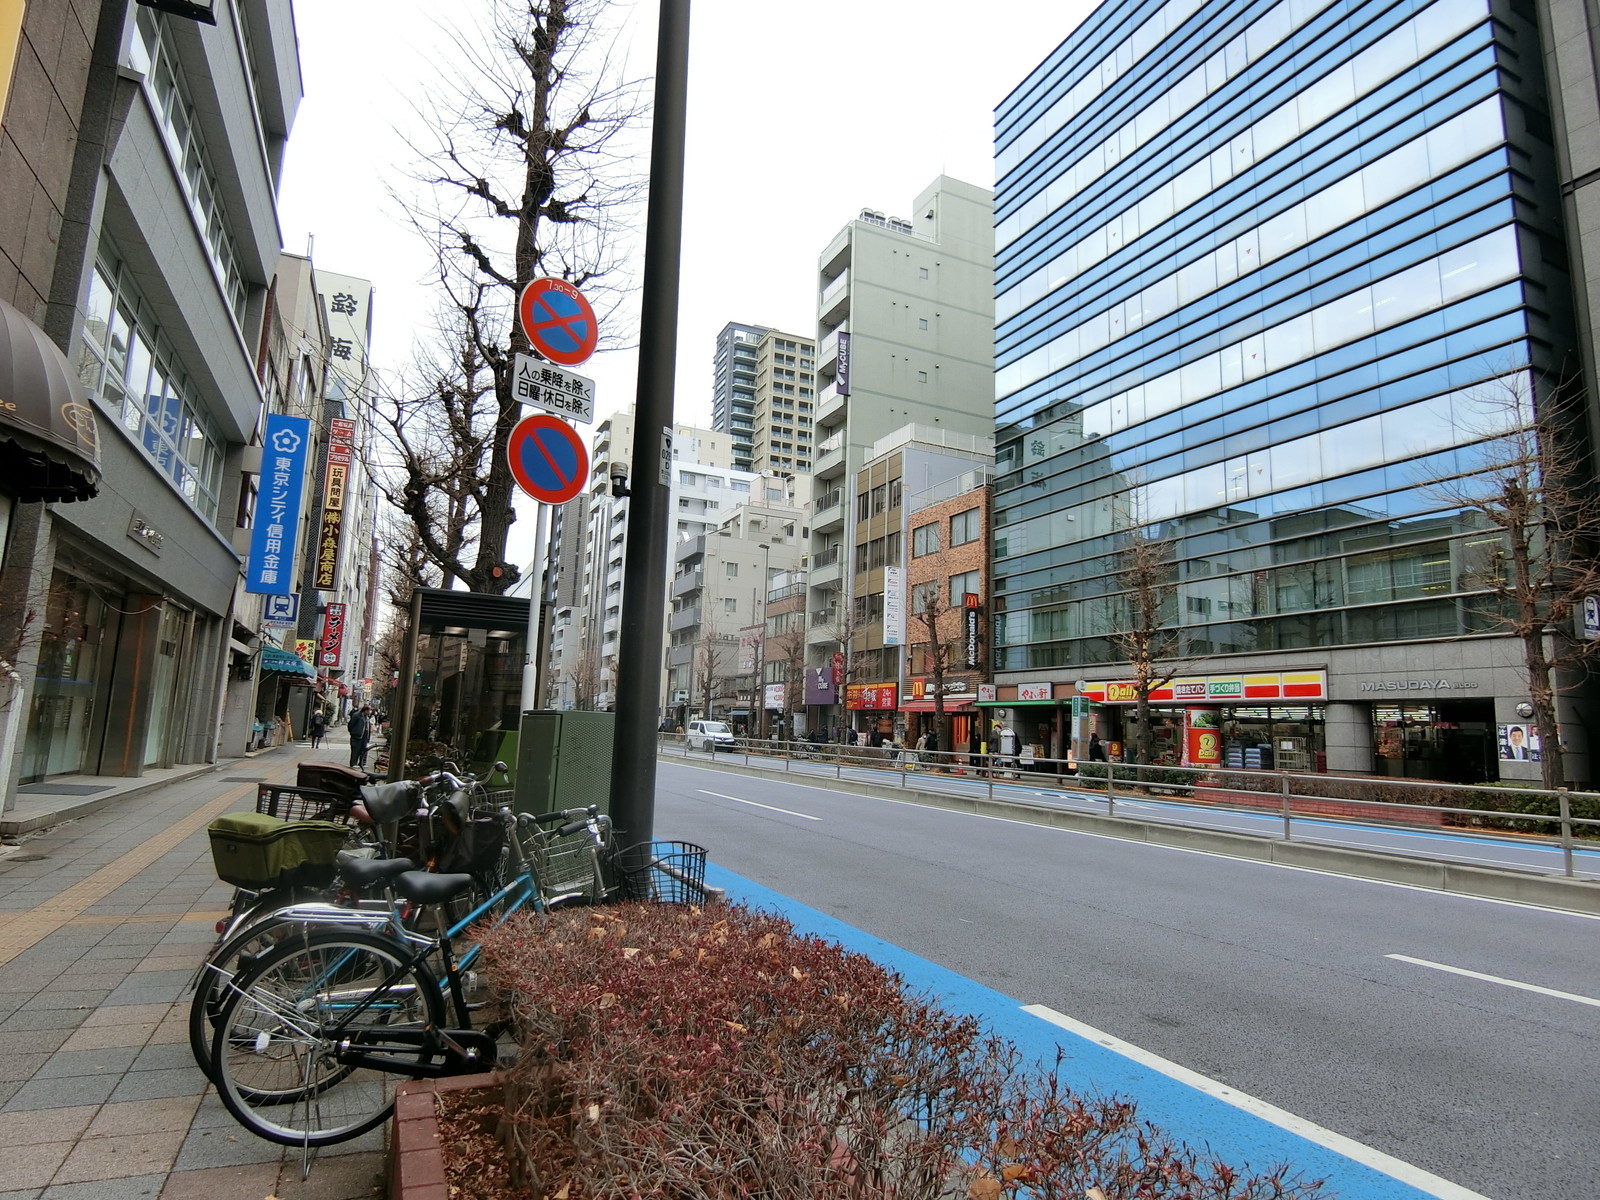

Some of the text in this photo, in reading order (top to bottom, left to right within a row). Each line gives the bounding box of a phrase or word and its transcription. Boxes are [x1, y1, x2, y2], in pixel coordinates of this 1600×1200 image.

[839, 338, 848, 374] MyCUBE
[518, 362, 591, 399] 人の乗降を除く
[328, 467, 344, 507] 玩具問屋
[260, 456, 292, 585] 東京シティ信用金庫
[325, 617, 341, 651] ラーメン
[968, 611, 976, 666] McDonald's
[1021, 688, 1048, 701] やよい軒
[1176, 684, 1205, 695] 焼きたてパン
[1210, 683, 1240, 694] 手づくり弁当
[1361, 679, 1451, 691] MASUDAYA
